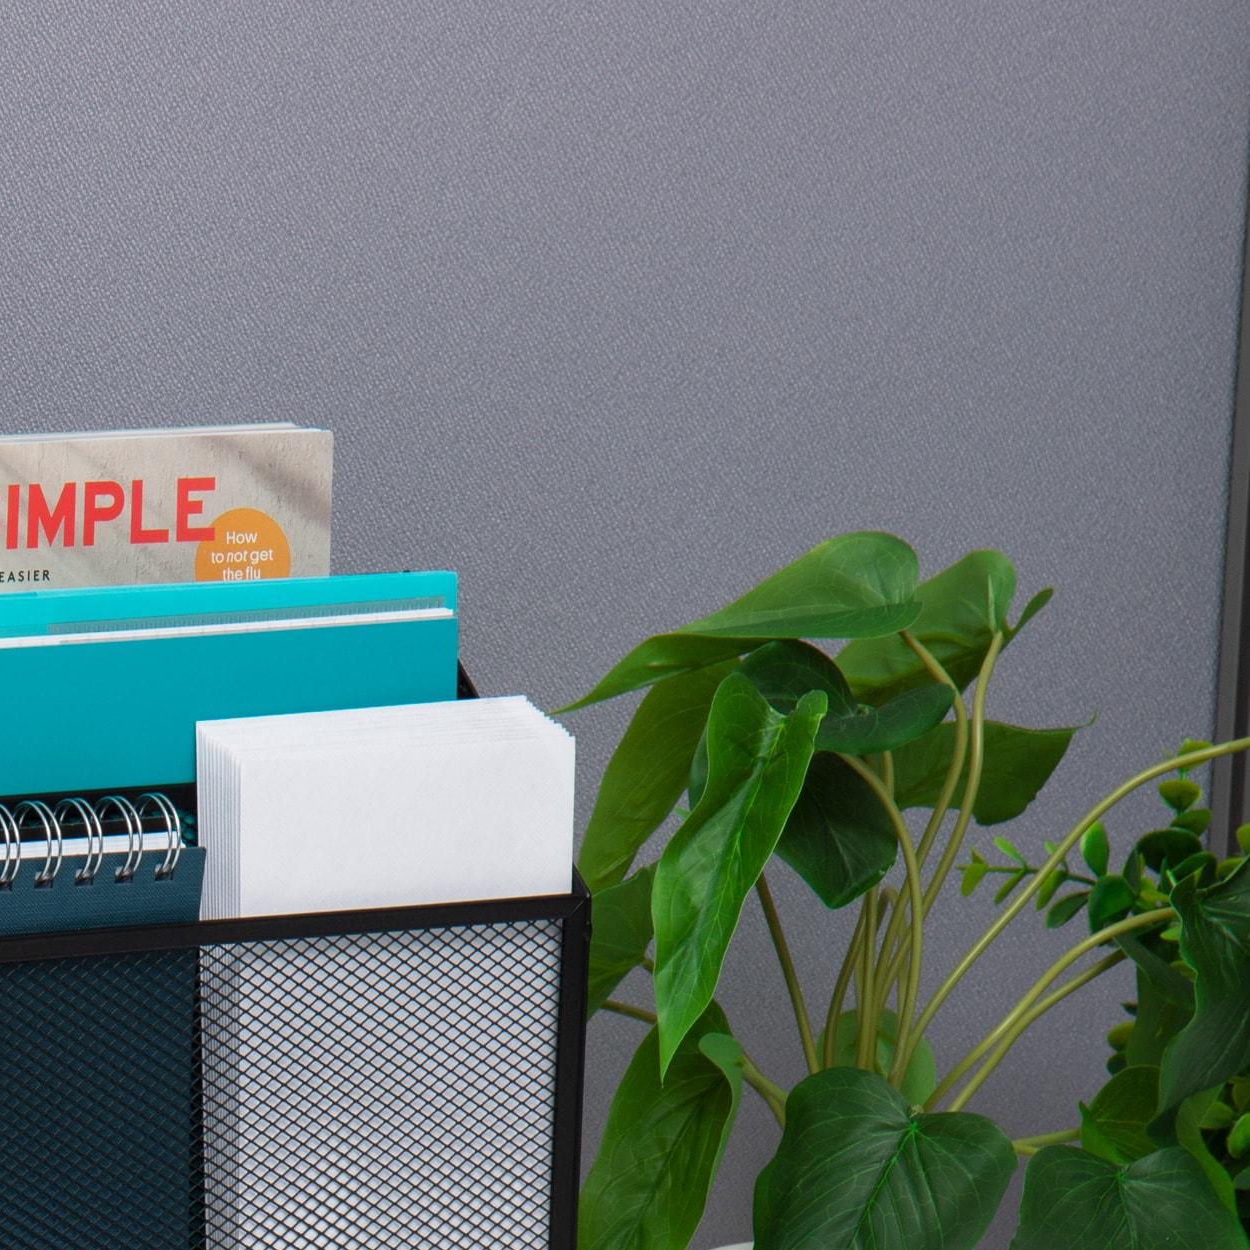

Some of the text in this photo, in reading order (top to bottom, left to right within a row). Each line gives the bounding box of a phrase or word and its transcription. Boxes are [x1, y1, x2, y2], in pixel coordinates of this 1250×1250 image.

[226, 531, 258, 545] How
[211, 548, 274, 565] to not get
[222, 566, 261, 581] the flu
